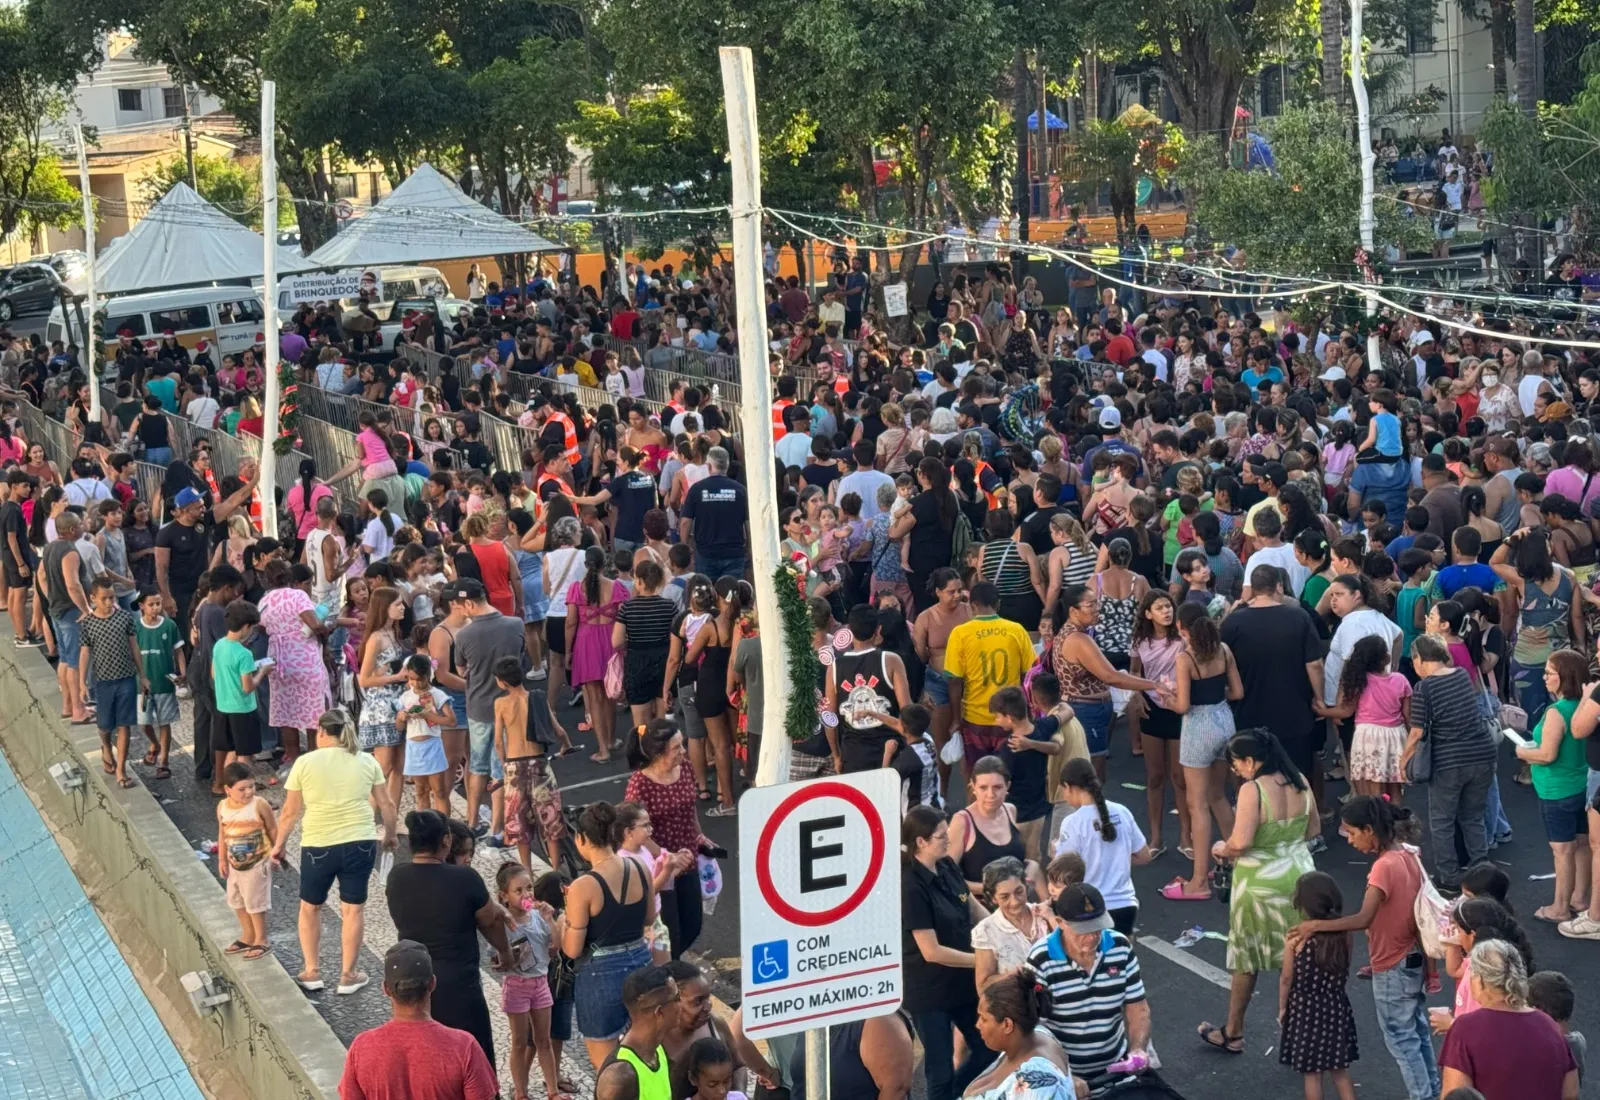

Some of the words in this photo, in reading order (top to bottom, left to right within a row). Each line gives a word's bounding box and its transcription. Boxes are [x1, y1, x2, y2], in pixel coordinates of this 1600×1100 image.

[293, 276, 347, 289] DISTRIBUIÇÃO
[348, 277, 359, 285] DE
[294, 286, 360, 298] BRINQUEDOS
[976, 628, 1008, 639] SEMOG
[979, 648, 1009, 687] 10
[799, 815, 847, 893] E
[796, 935, 830, 952] COM
[797, 944, 892, 972] CREDENCIAL
[752, 997, 804, 1019] TEMPO
[809, 985, 873, 1008] MÁXIMO:
[877, 981, 894, 995] 2h
